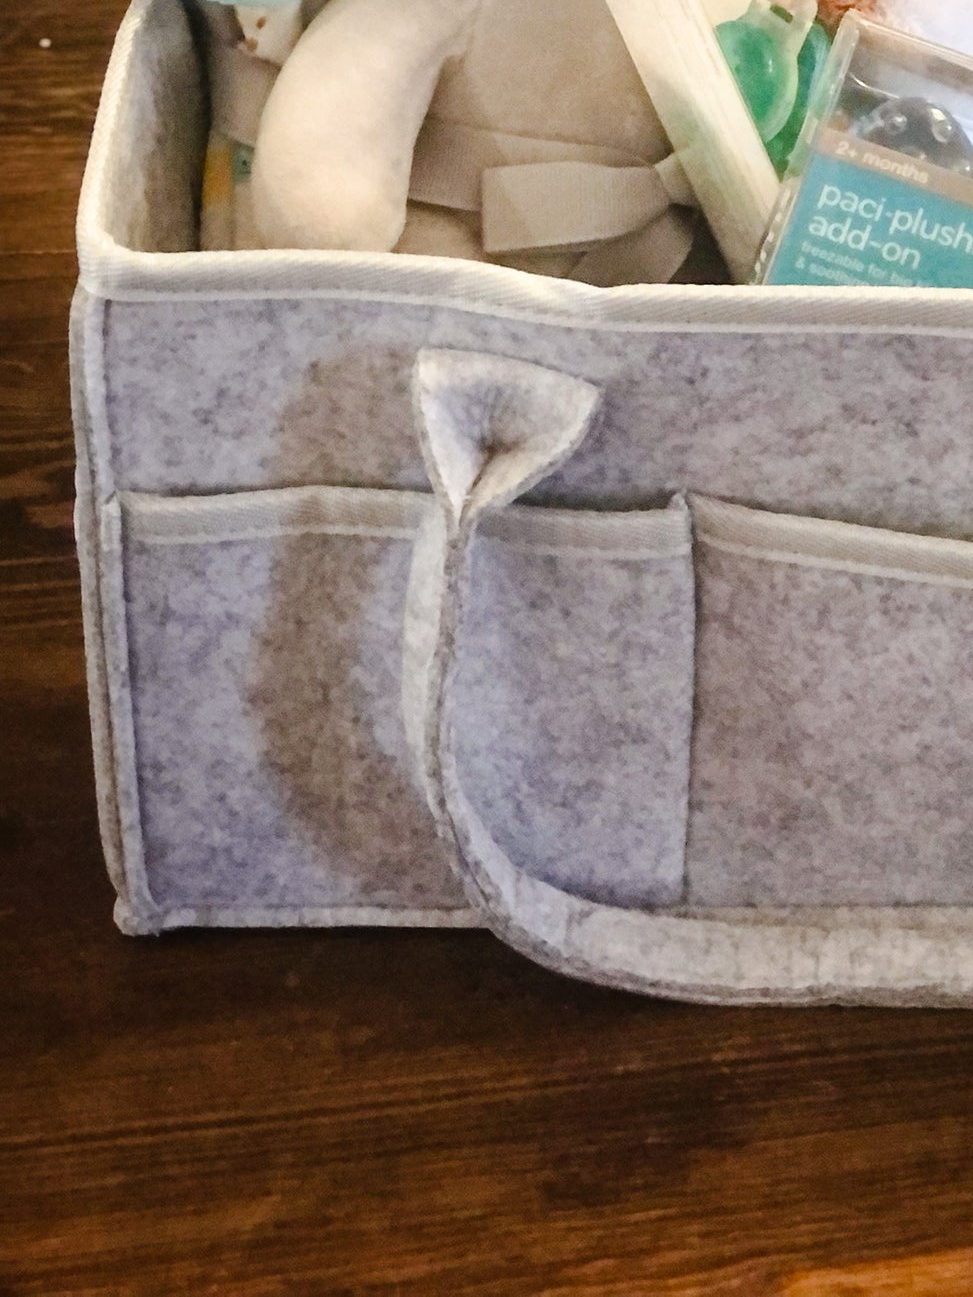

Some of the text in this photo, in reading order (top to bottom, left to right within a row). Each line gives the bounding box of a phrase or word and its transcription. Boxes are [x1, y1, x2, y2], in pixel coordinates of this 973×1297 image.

[835, 140, 929, 184] 2+ months
[808, 214, 921, 270] add-on
